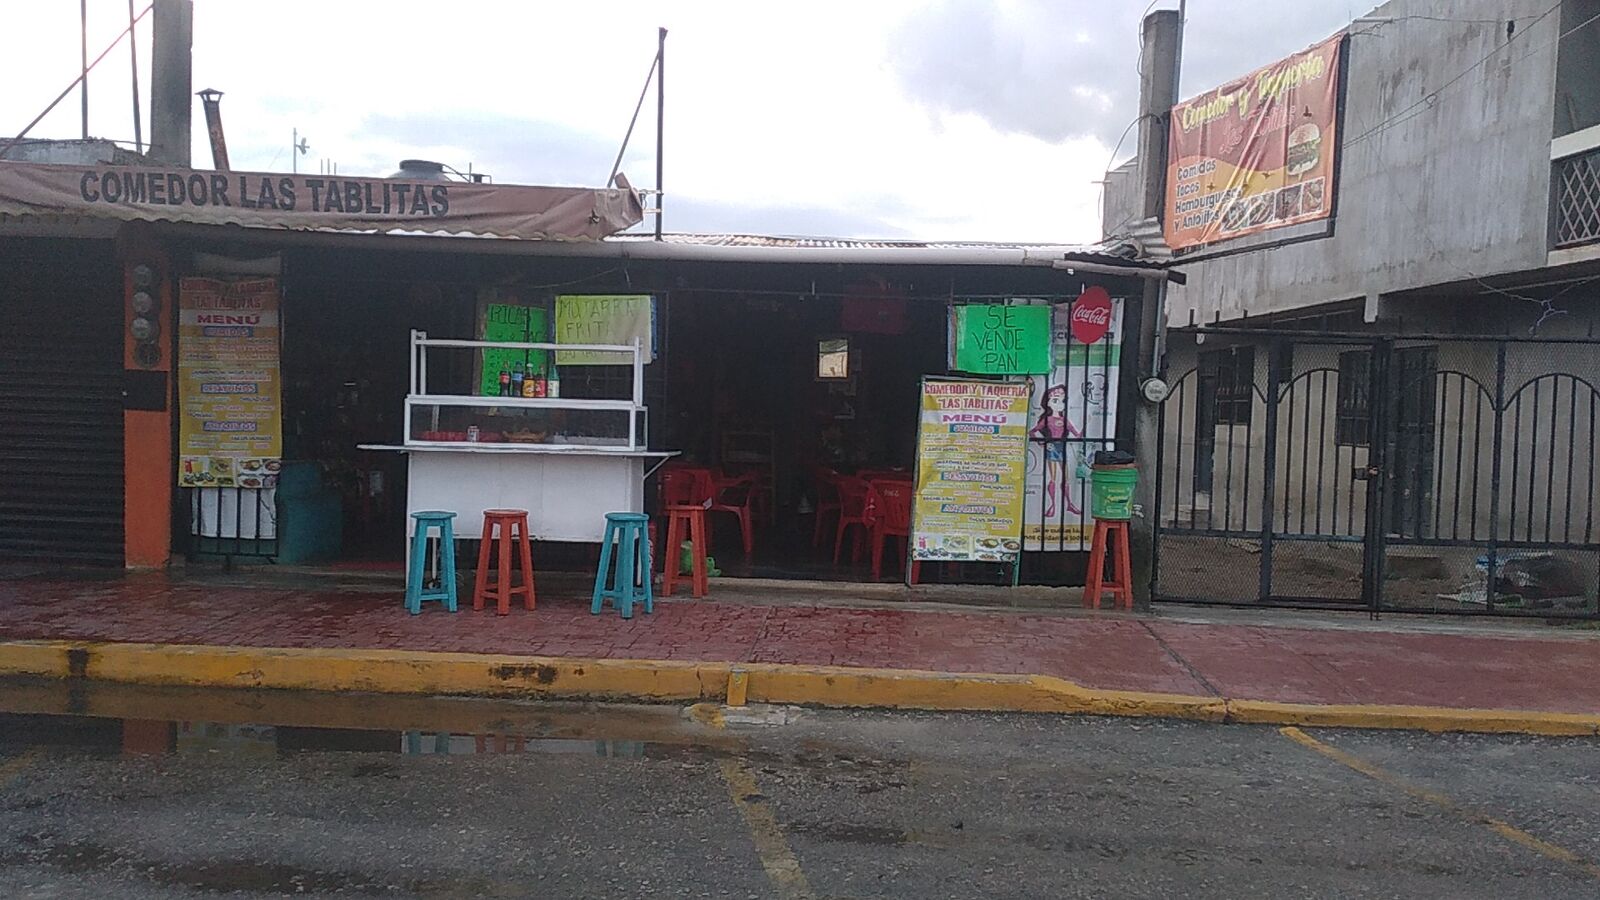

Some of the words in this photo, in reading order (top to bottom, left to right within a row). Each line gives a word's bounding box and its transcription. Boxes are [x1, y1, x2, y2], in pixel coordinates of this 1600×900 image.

[1177, 159, 1217, 181] Comidas
[80, 170, 232, 207] COMEDOR
[239, 176, 296, 211] LAS
[305, 179, 450, 217] TABLITAS
[1176, 182, 1200, 197] Tacos
[197, 313, 260, 325] MENÚ
[983, 305, 1017, 329] SE
[973, 328, 1025, 351] VENDE
[981, 352, 1018, 372] PAN
[924, 384, 967, 395] COMEDOR
[970, 385, 978, 394] Y
[943, 414, 1007, 424] MENÚ
